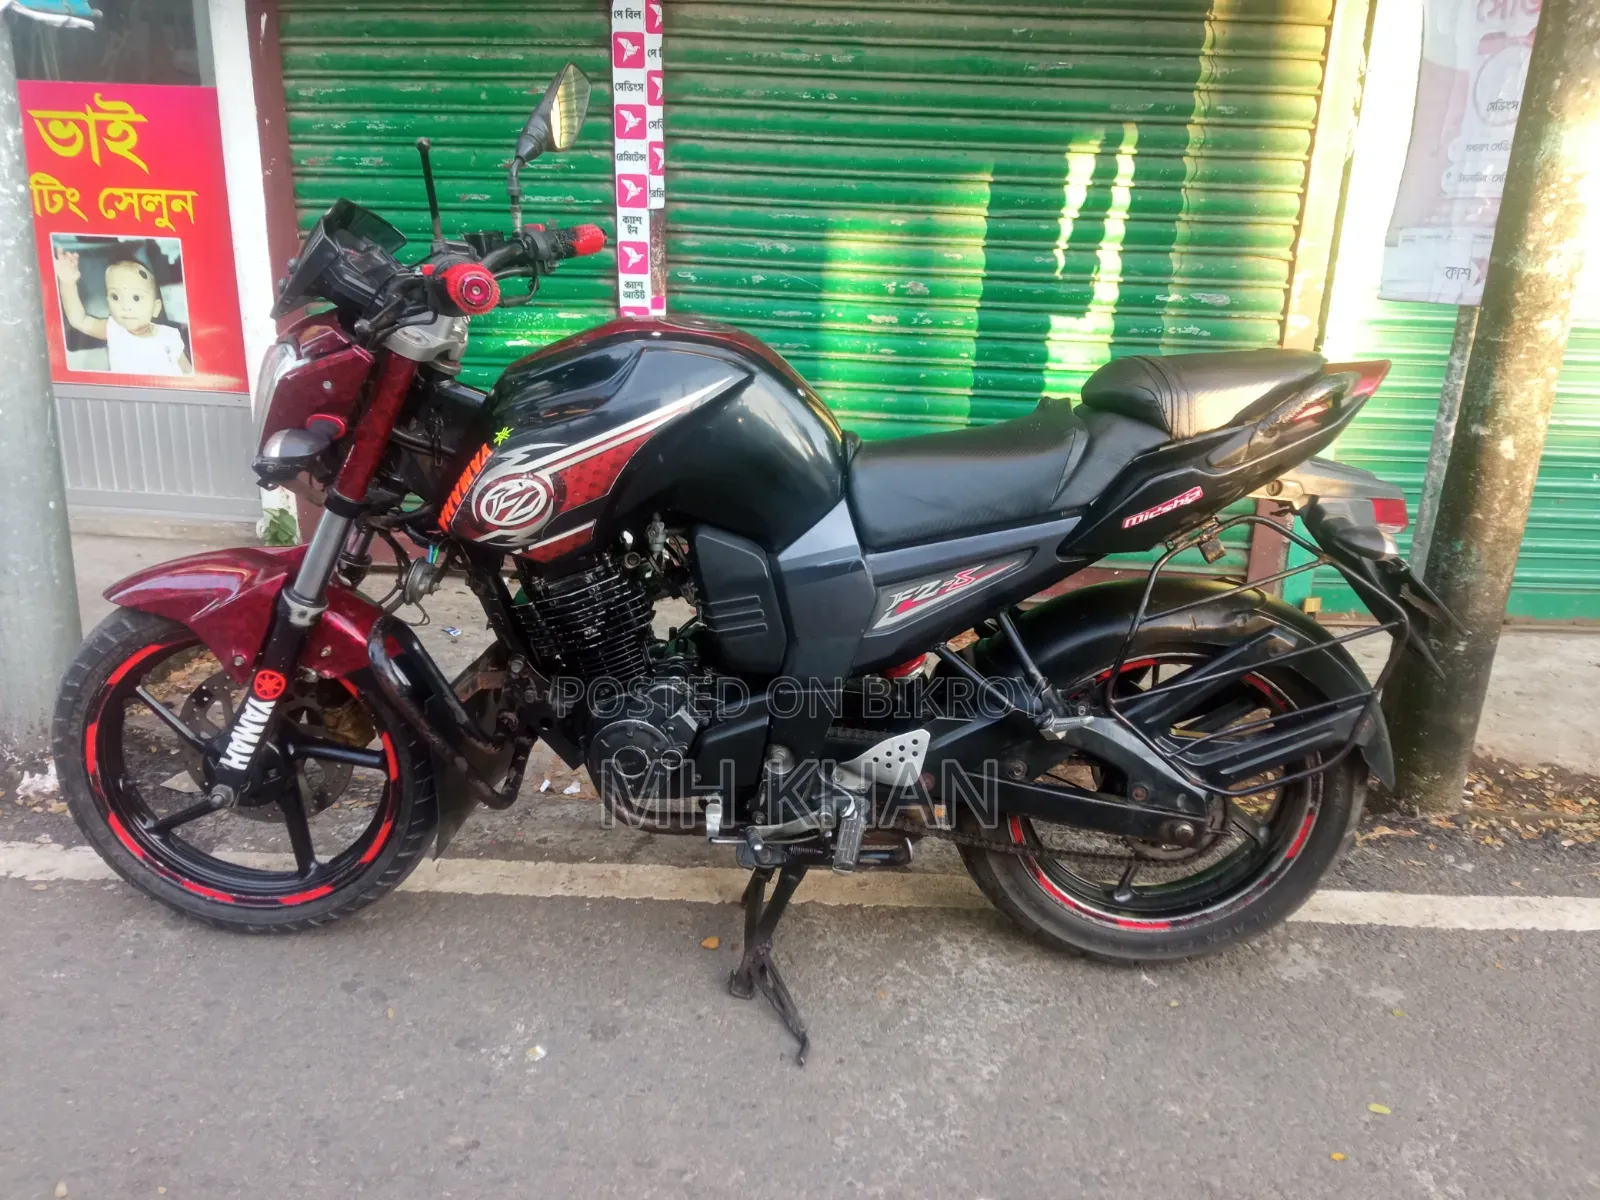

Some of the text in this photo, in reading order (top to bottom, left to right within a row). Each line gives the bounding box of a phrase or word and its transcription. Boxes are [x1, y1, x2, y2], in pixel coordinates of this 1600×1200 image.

[613, 8, 642, 19] পে বিল
[614, 80, 644, 92] সেভিংস
[27, 92, 150, 175] ভাই
[28, 171, 200, 233] টিং সেলুন
